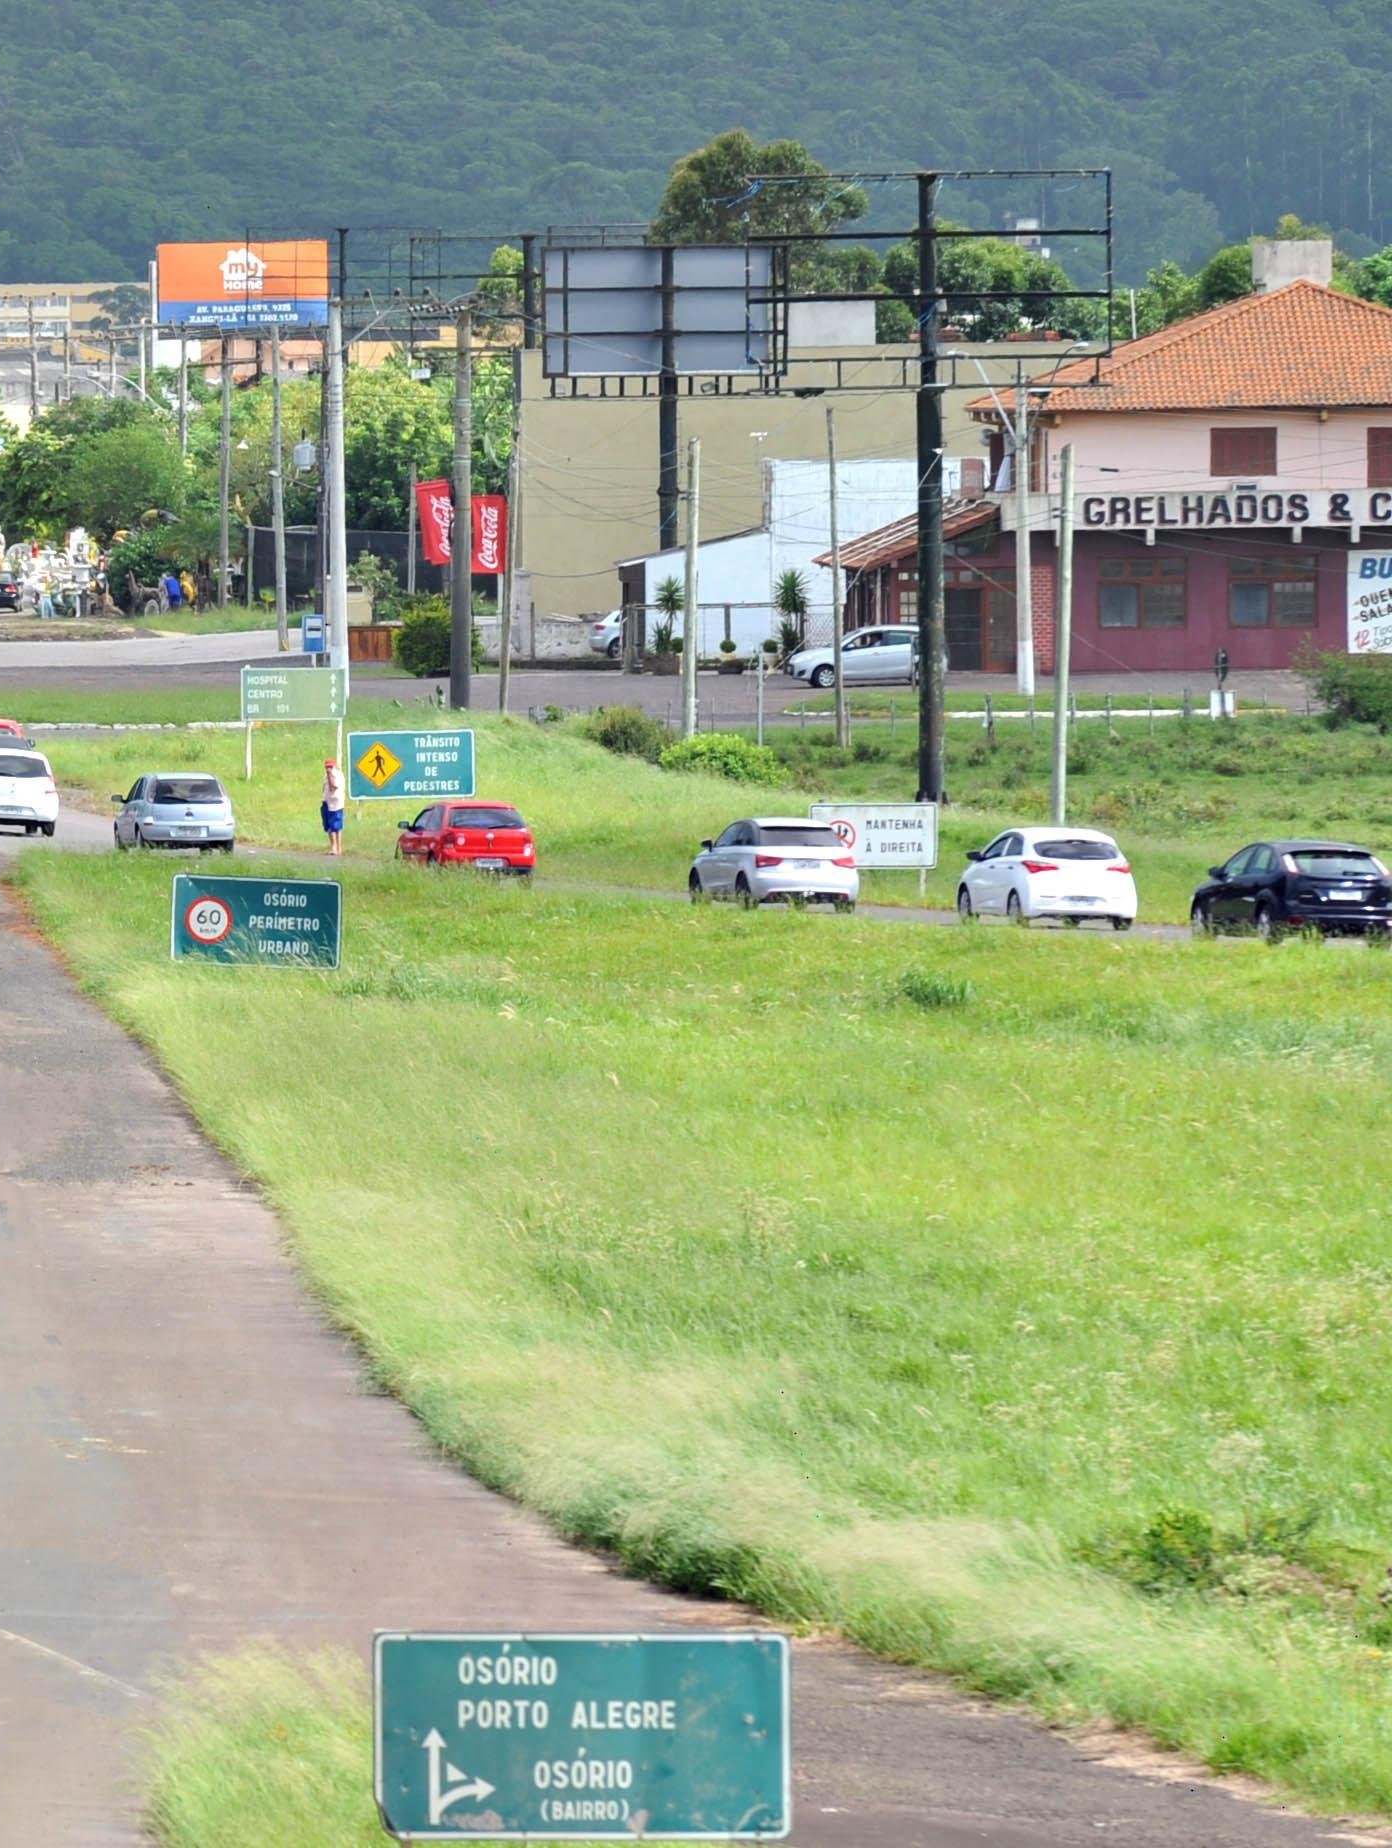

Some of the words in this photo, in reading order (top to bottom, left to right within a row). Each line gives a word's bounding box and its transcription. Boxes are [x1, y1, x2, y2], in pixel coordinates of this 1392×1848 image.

[228, 262, 258, 277] my
[1083, 493, 1310, 527] GRELHADOS
[1328, 493, 1352, 522] &
[247, 675, 288, 685] HOSPITAL
[247, 689, 284, 699] CENTRO
[276, 703, 290, 714] 101
[413, 734, 461, 749] TRÂNSITO
[416, 752, 459, 763] INTENSO
[424, 766, 439, 777] DE
[404, 780, 461, 792] PEDESTRES
[865, 819, 924, 831] MANTENHA
[880, 842, 924, 853] DIREITA
[263, 889, 308, 908] OSÓRIO
[196, 910, 221, 925] 60
[249, 910, 320, 931] PERÍMETRO
[258, 939, 310, 955] URBANO
[458, 1643, 557, 1685] OSÓRIO
[457, 1700, 549, 1729] PORTO
[571, 1700, 677, 1729] ALEGRE
[534, 1747, 633, 1789] OSÓRIO
[540, 1798, 630, 1822] (BAIRRO)
